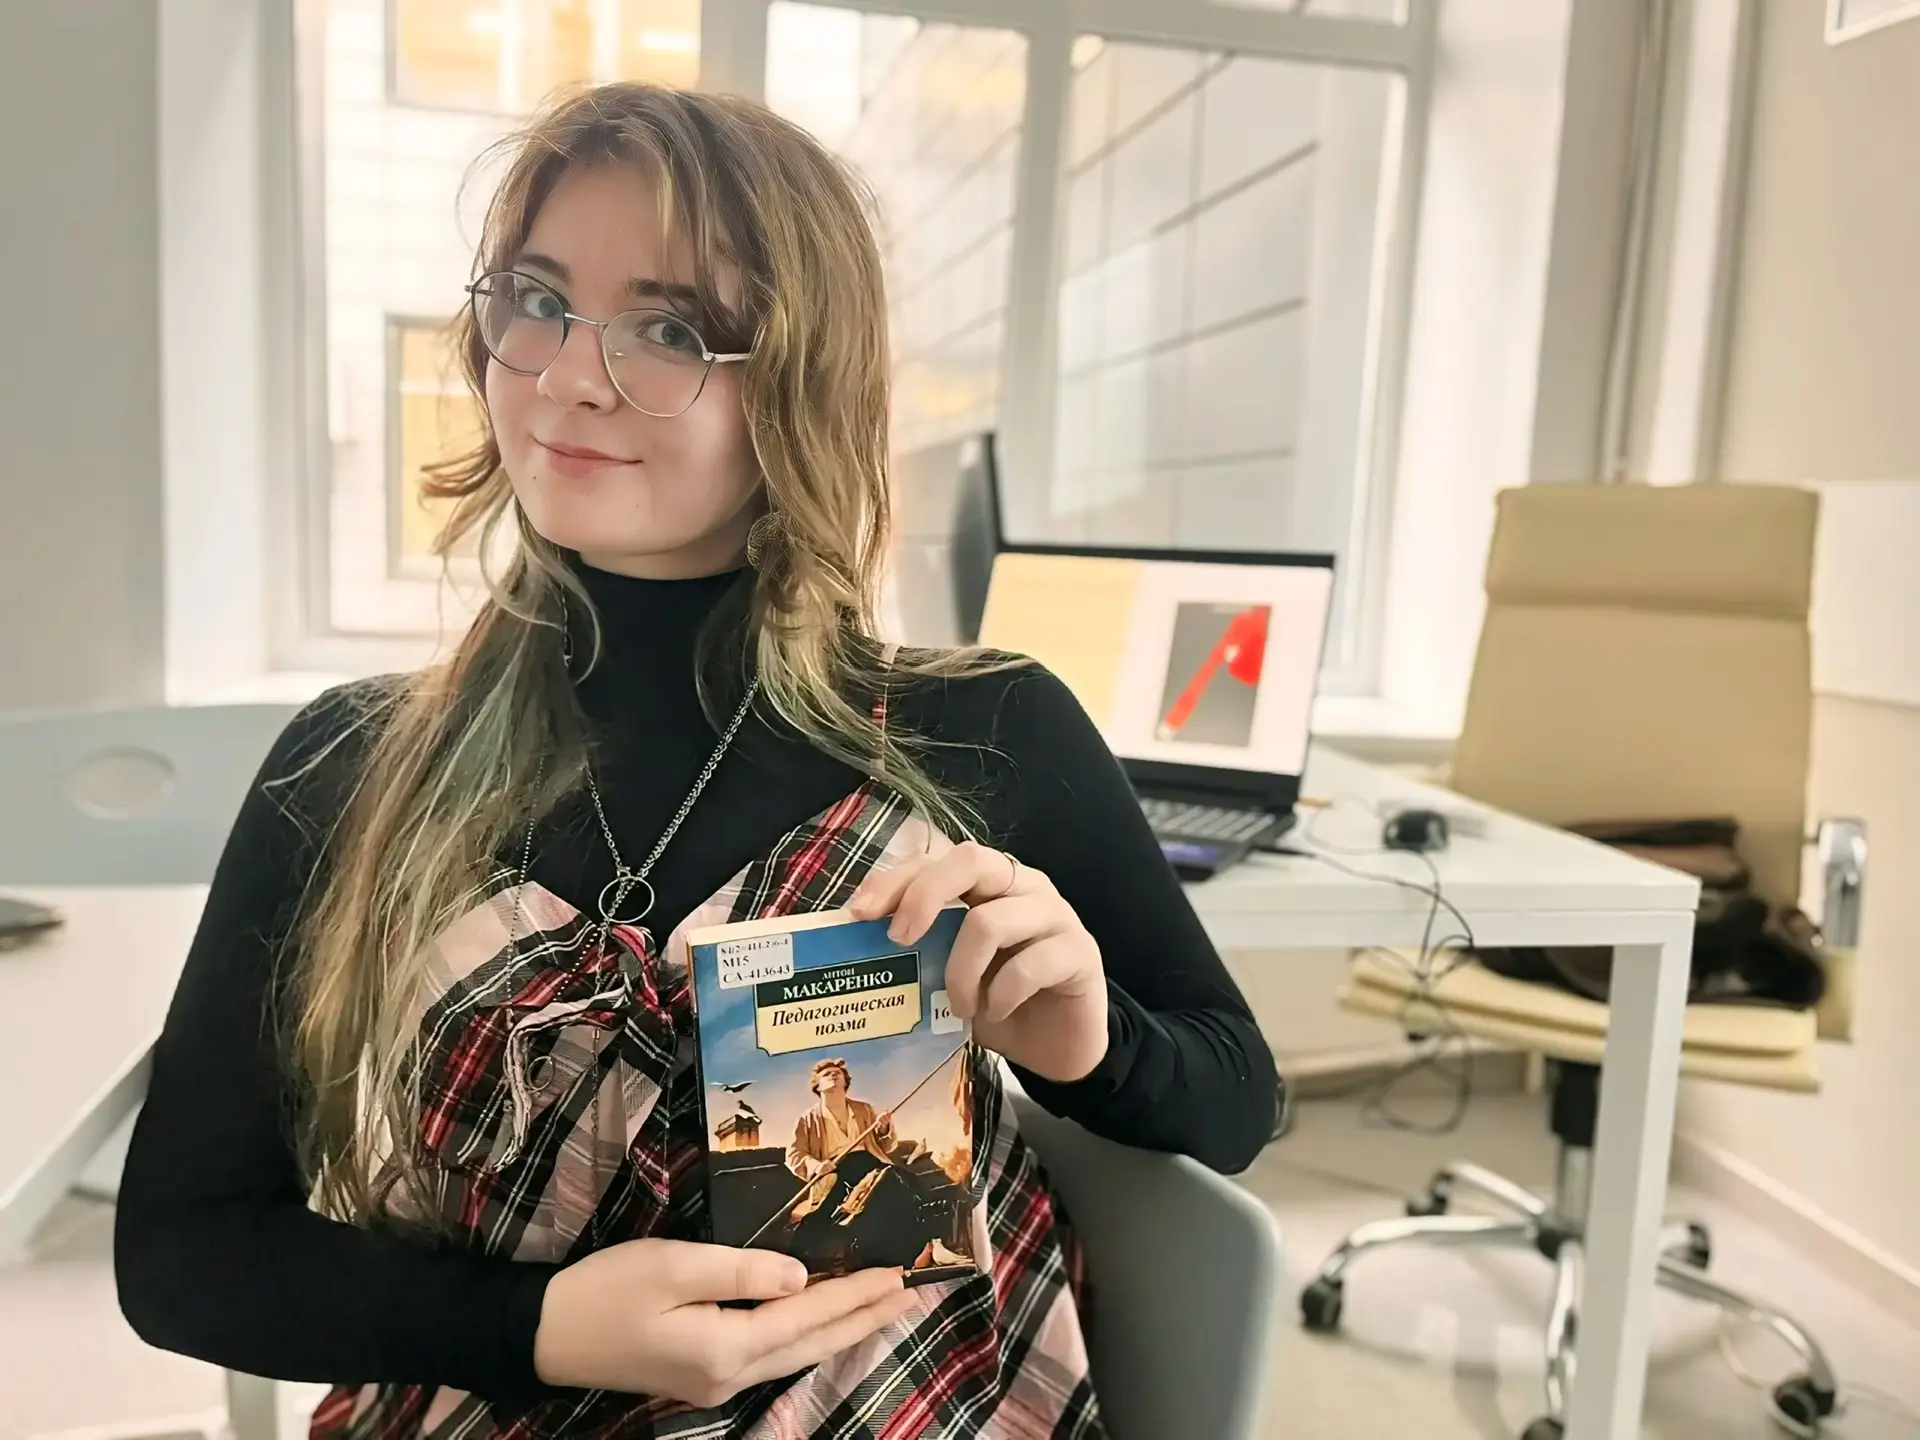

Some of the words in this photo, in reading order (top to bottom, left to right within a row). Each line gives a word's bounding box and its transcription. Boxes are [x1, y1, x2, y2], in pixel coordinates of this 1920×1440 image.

[783, 970, 893, 1000] МАКАРЕНКО
[821, 967, 855, 980] АНТОН
[772, 994, 905, 1026] Педагогическая
[815, 1017, 867, 1036] поэма
